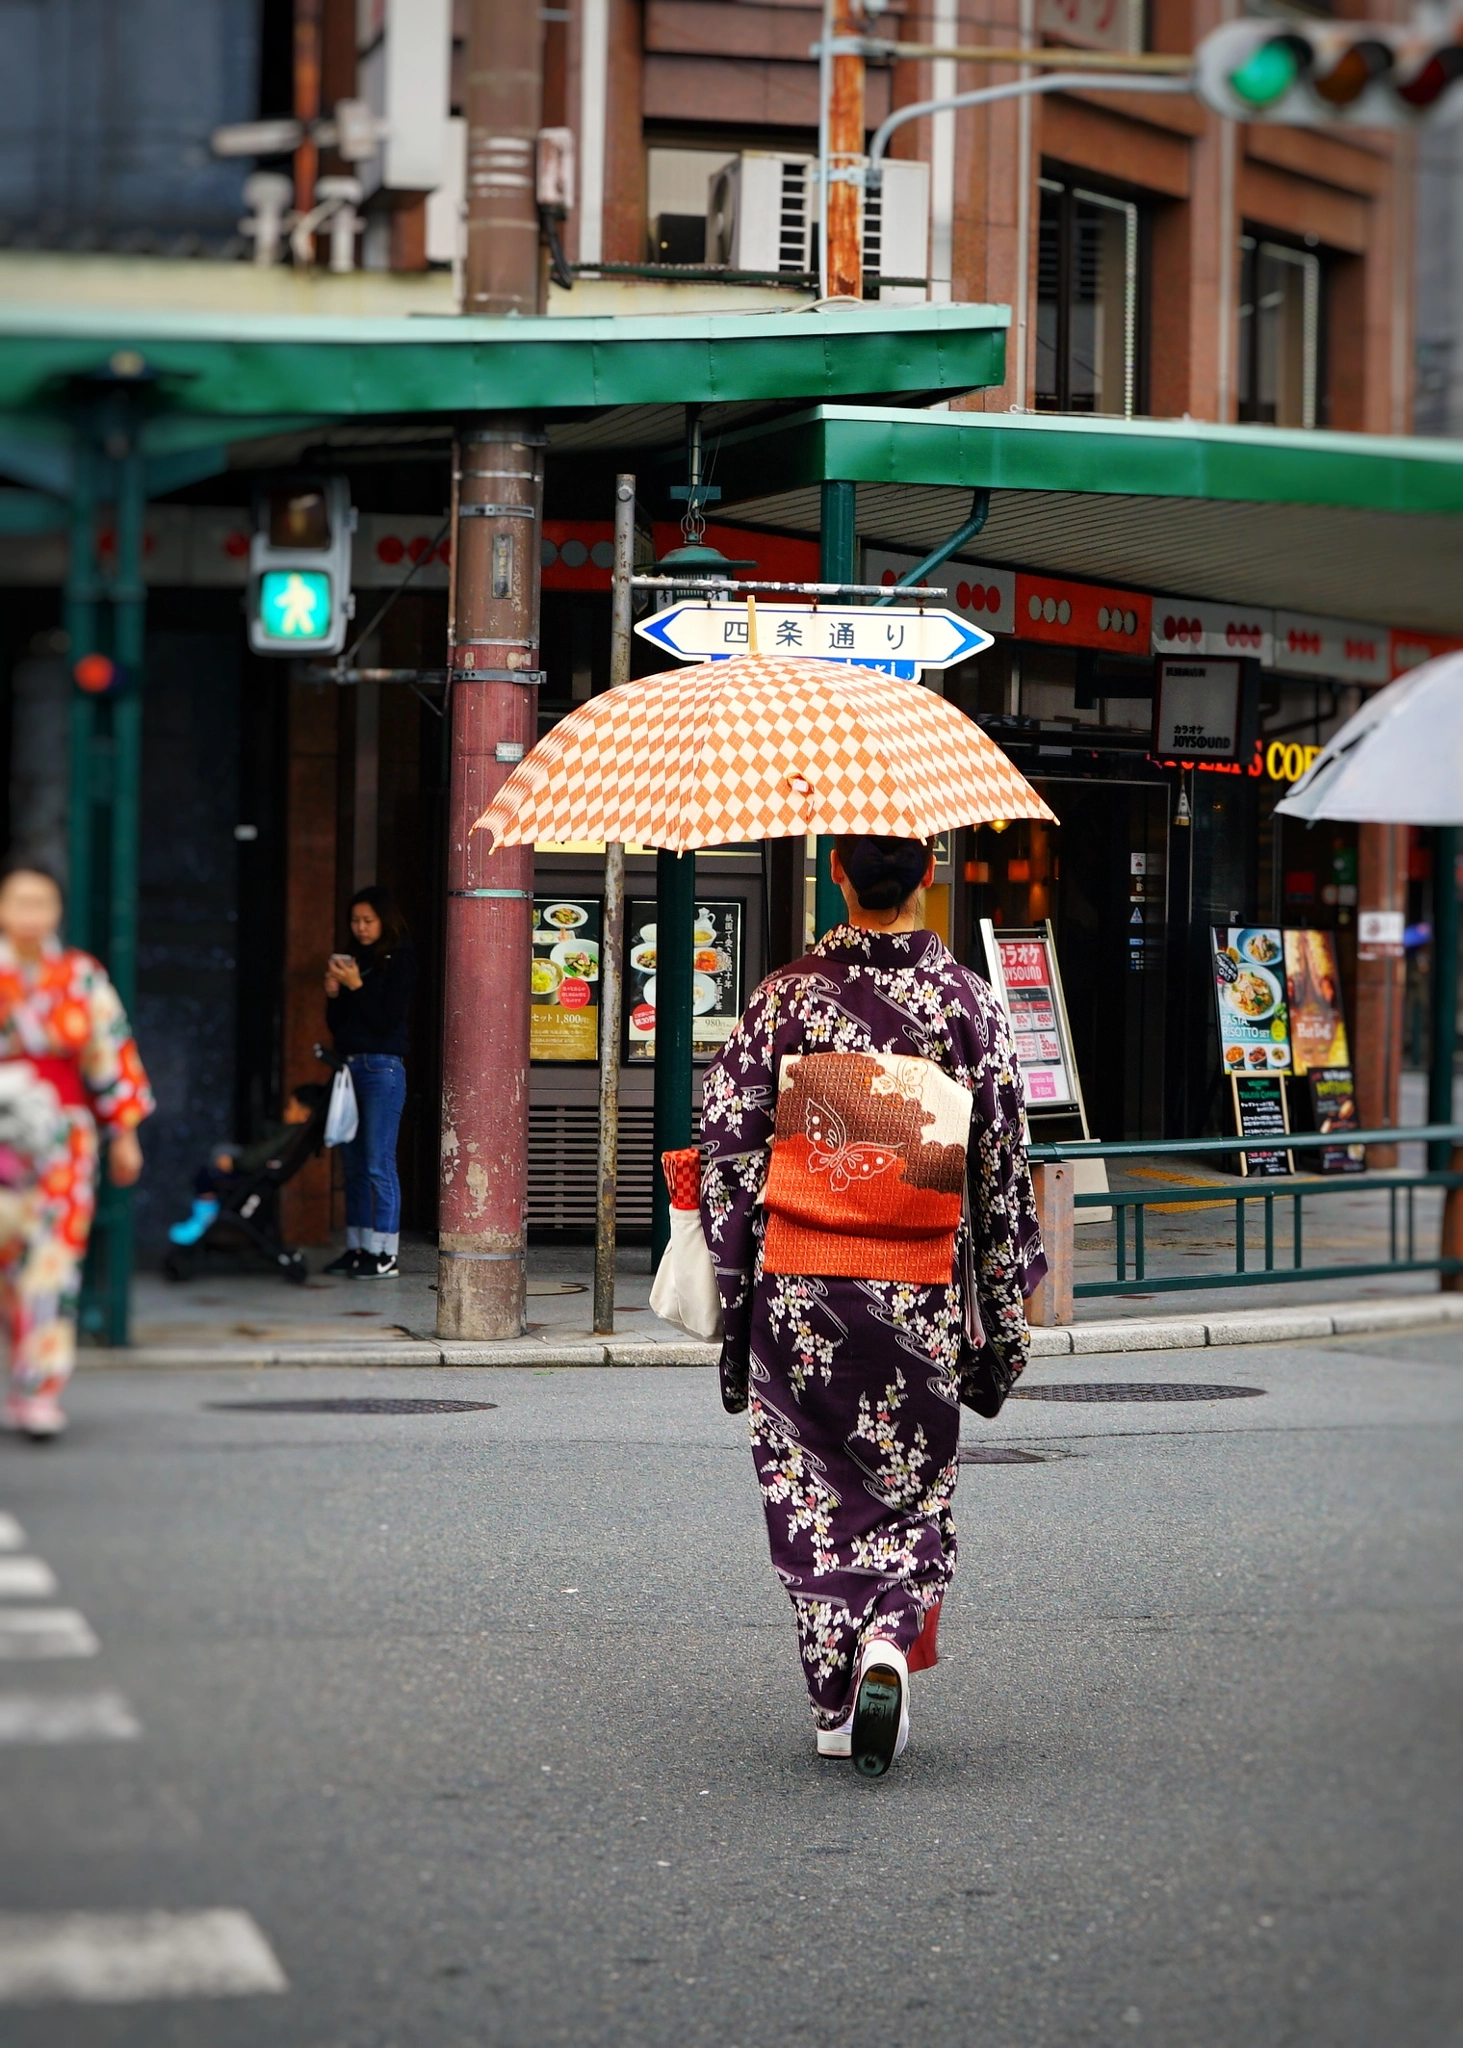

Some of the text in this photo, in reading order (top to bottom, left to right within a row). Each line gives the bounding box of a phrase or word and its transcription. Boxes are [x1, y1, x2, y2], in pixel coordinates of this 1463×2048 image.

[724, 619, 905, 650] 四条通り
[1174, 725, 1204, 735] カラオケ
[1173, 735, 1230, 749] JOYSOUND
